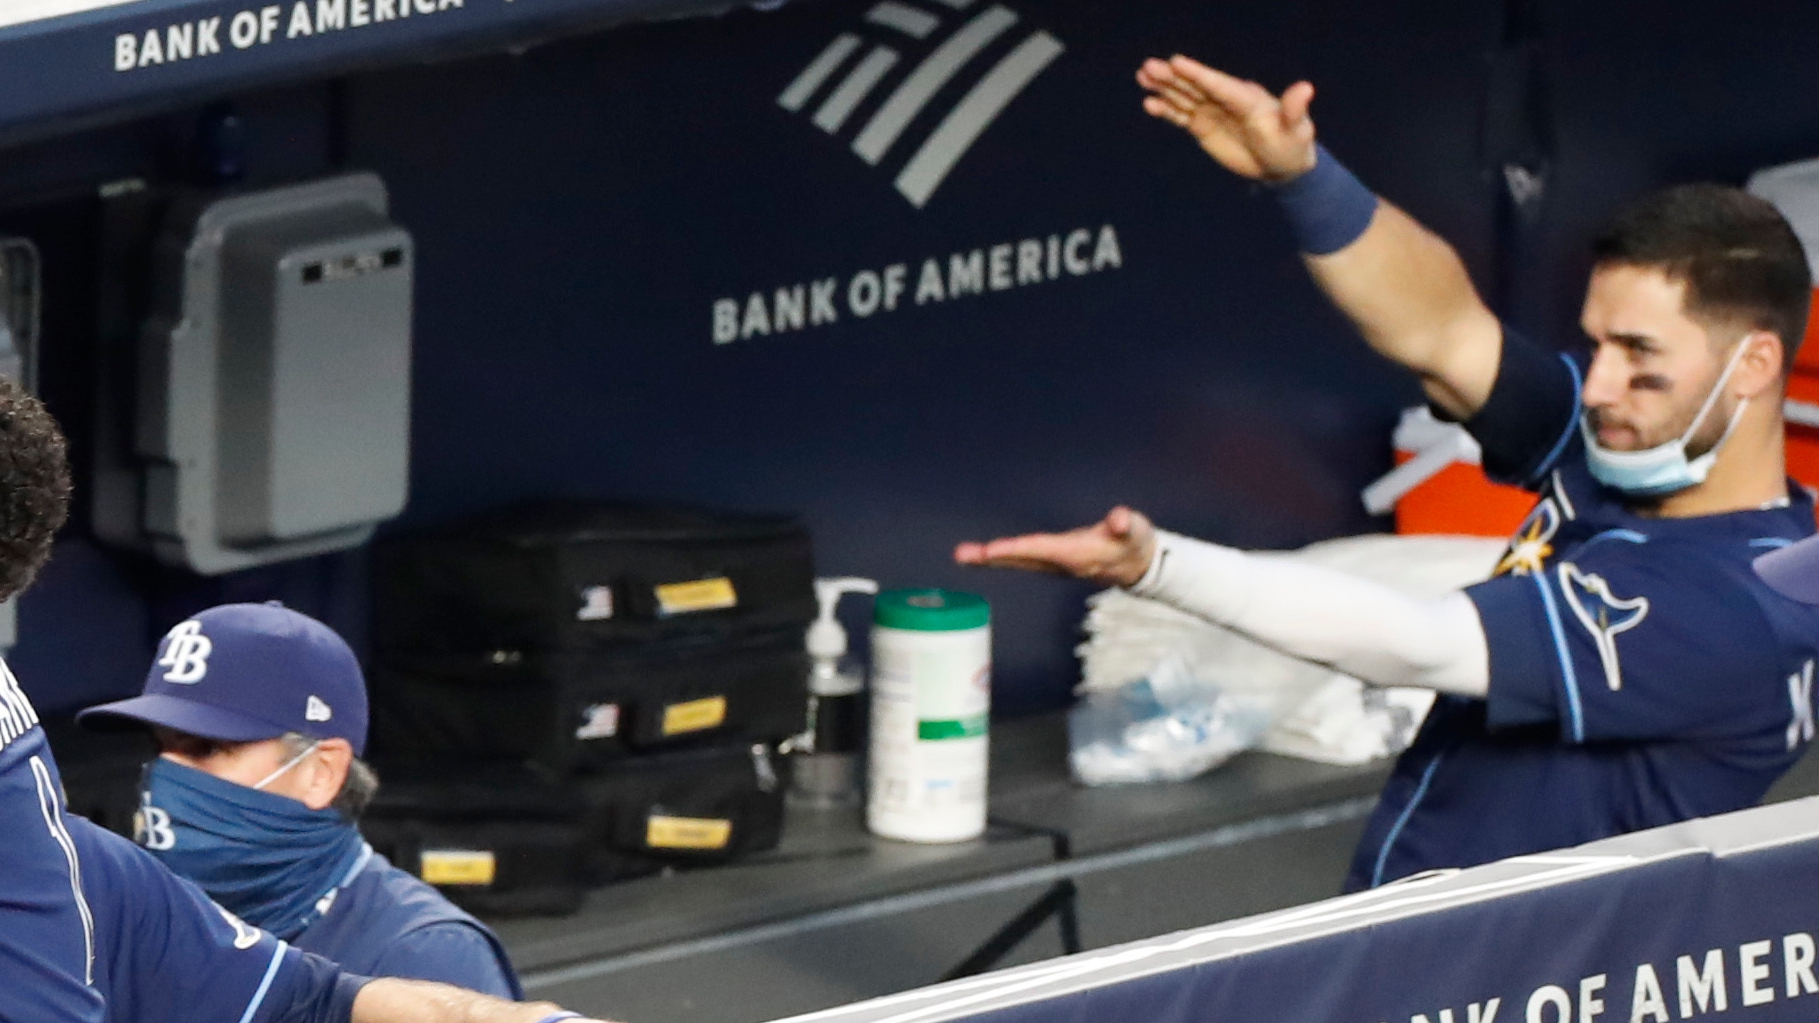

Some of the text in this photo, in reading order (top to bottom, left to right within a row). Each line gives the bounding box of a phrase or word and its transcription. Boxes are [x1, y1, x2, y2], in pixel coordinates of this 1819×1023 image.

[115, 0, 464, 71] BANK OF AMER
[714, 227, 1120, 342] BANK OF AMERICA
[158, 619, 213, 685] TB
[142, 790, 177, 851] B
